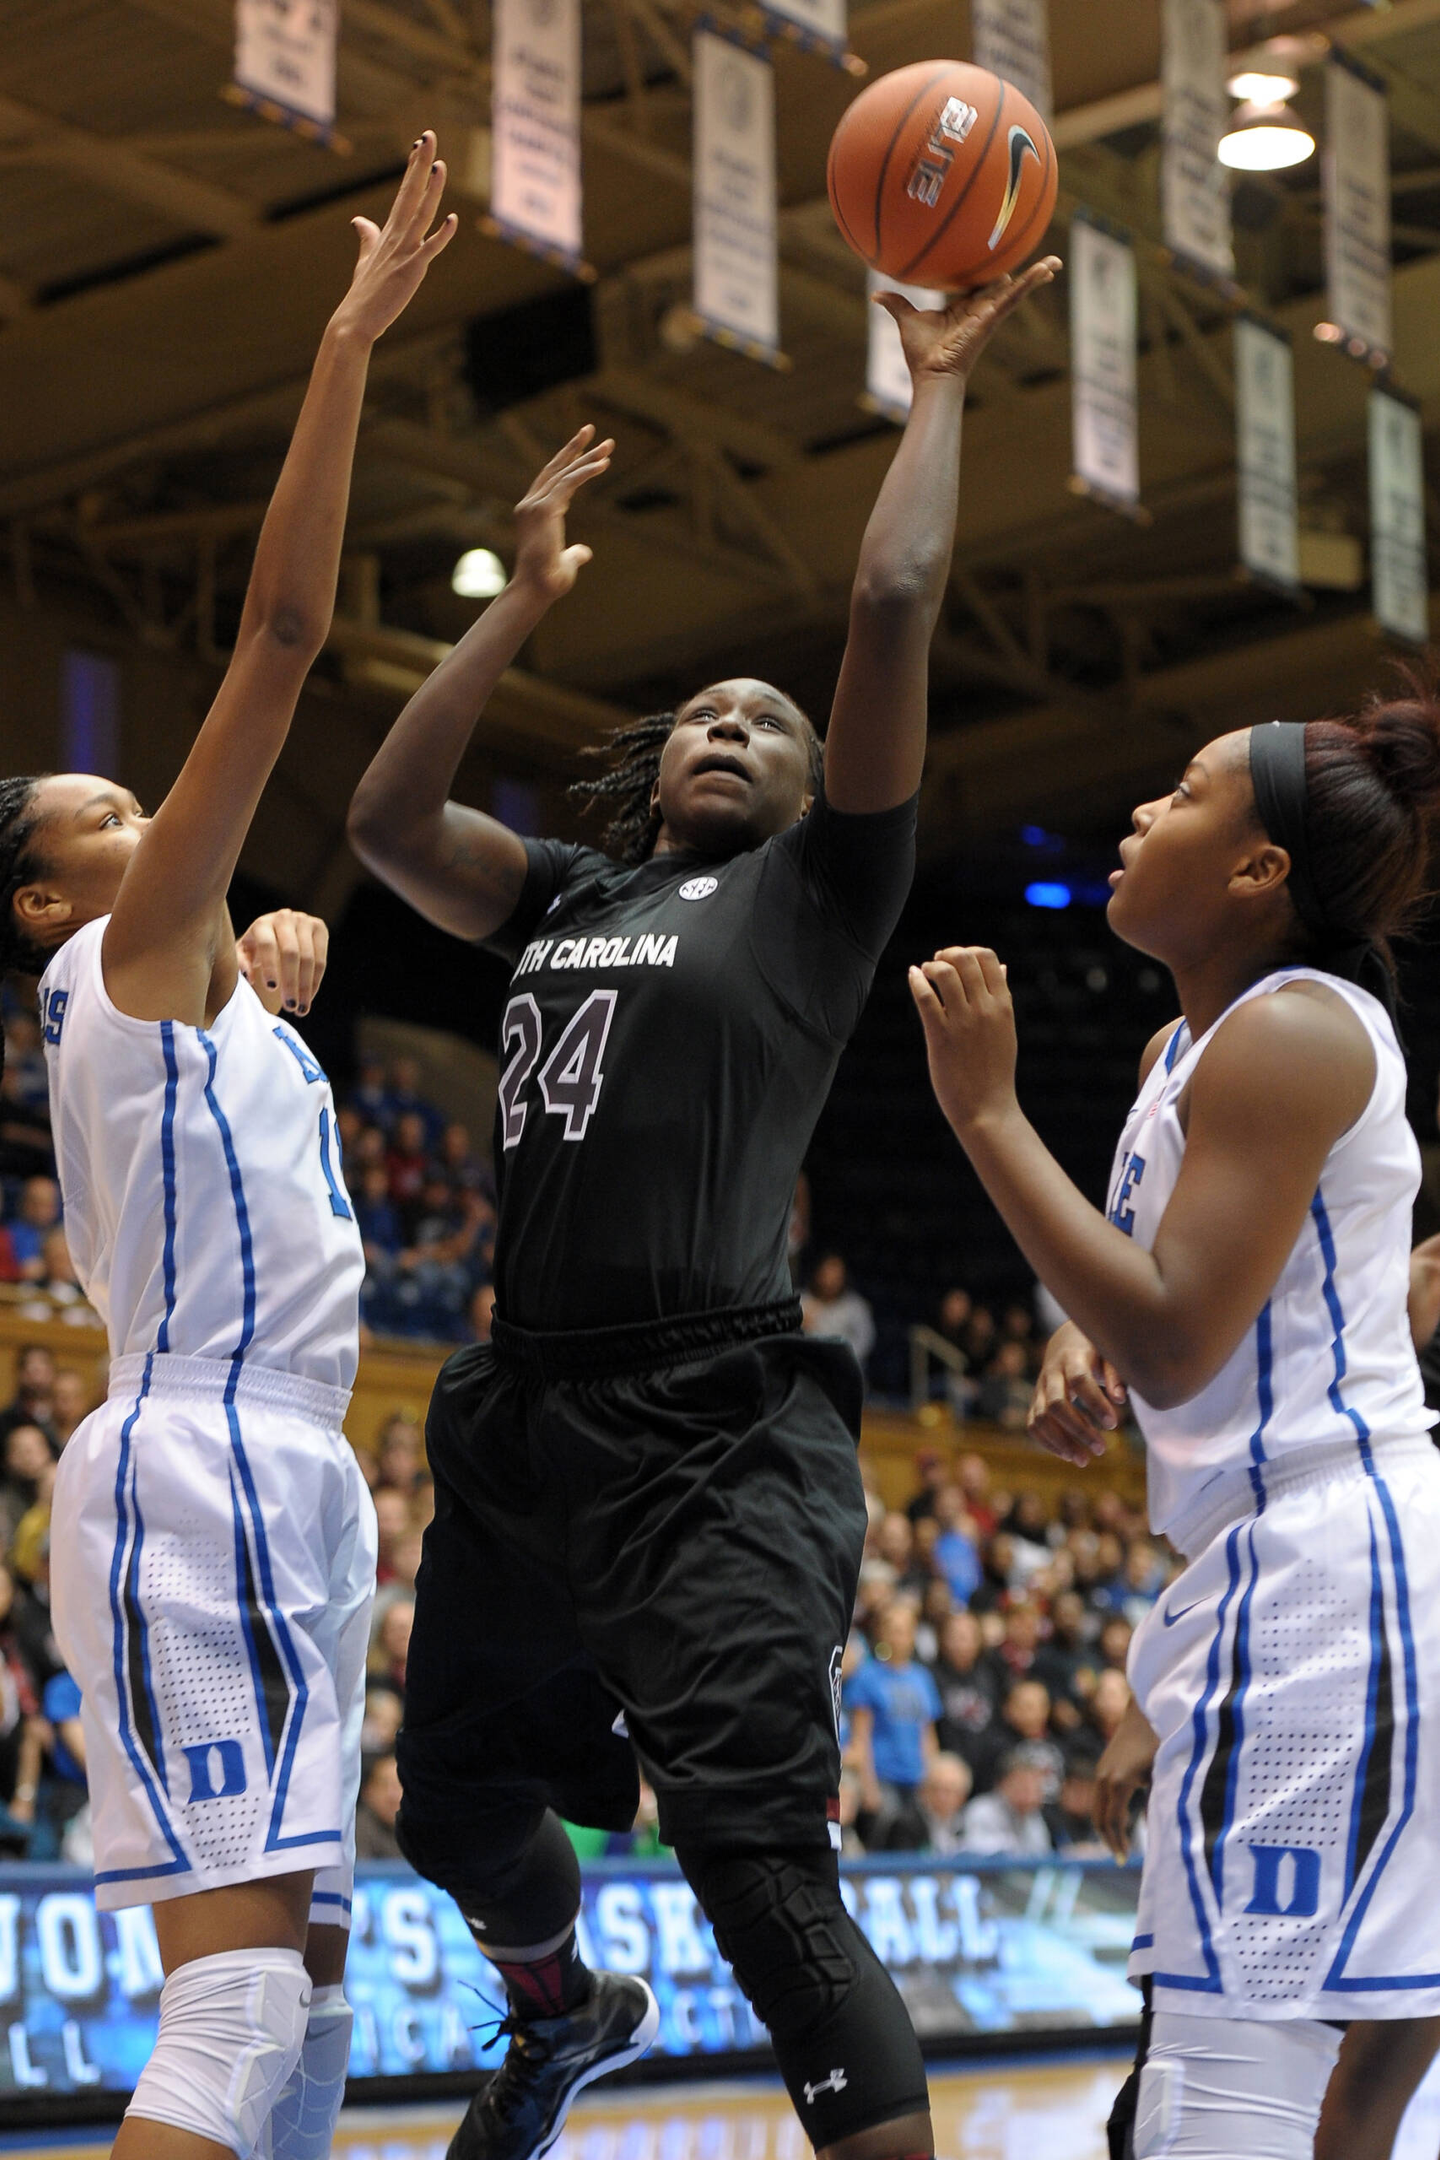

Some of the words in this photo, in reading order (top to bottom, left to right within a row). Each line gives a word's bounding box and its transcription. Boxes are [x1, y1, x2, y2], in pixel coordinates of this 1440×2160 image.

[550, 934, 679, 971] CAROLINA
[498, 988, 618, 1152] 24
[182, 1739, 247, 1805] D
[1243, 1844, 1321, 1917] D
